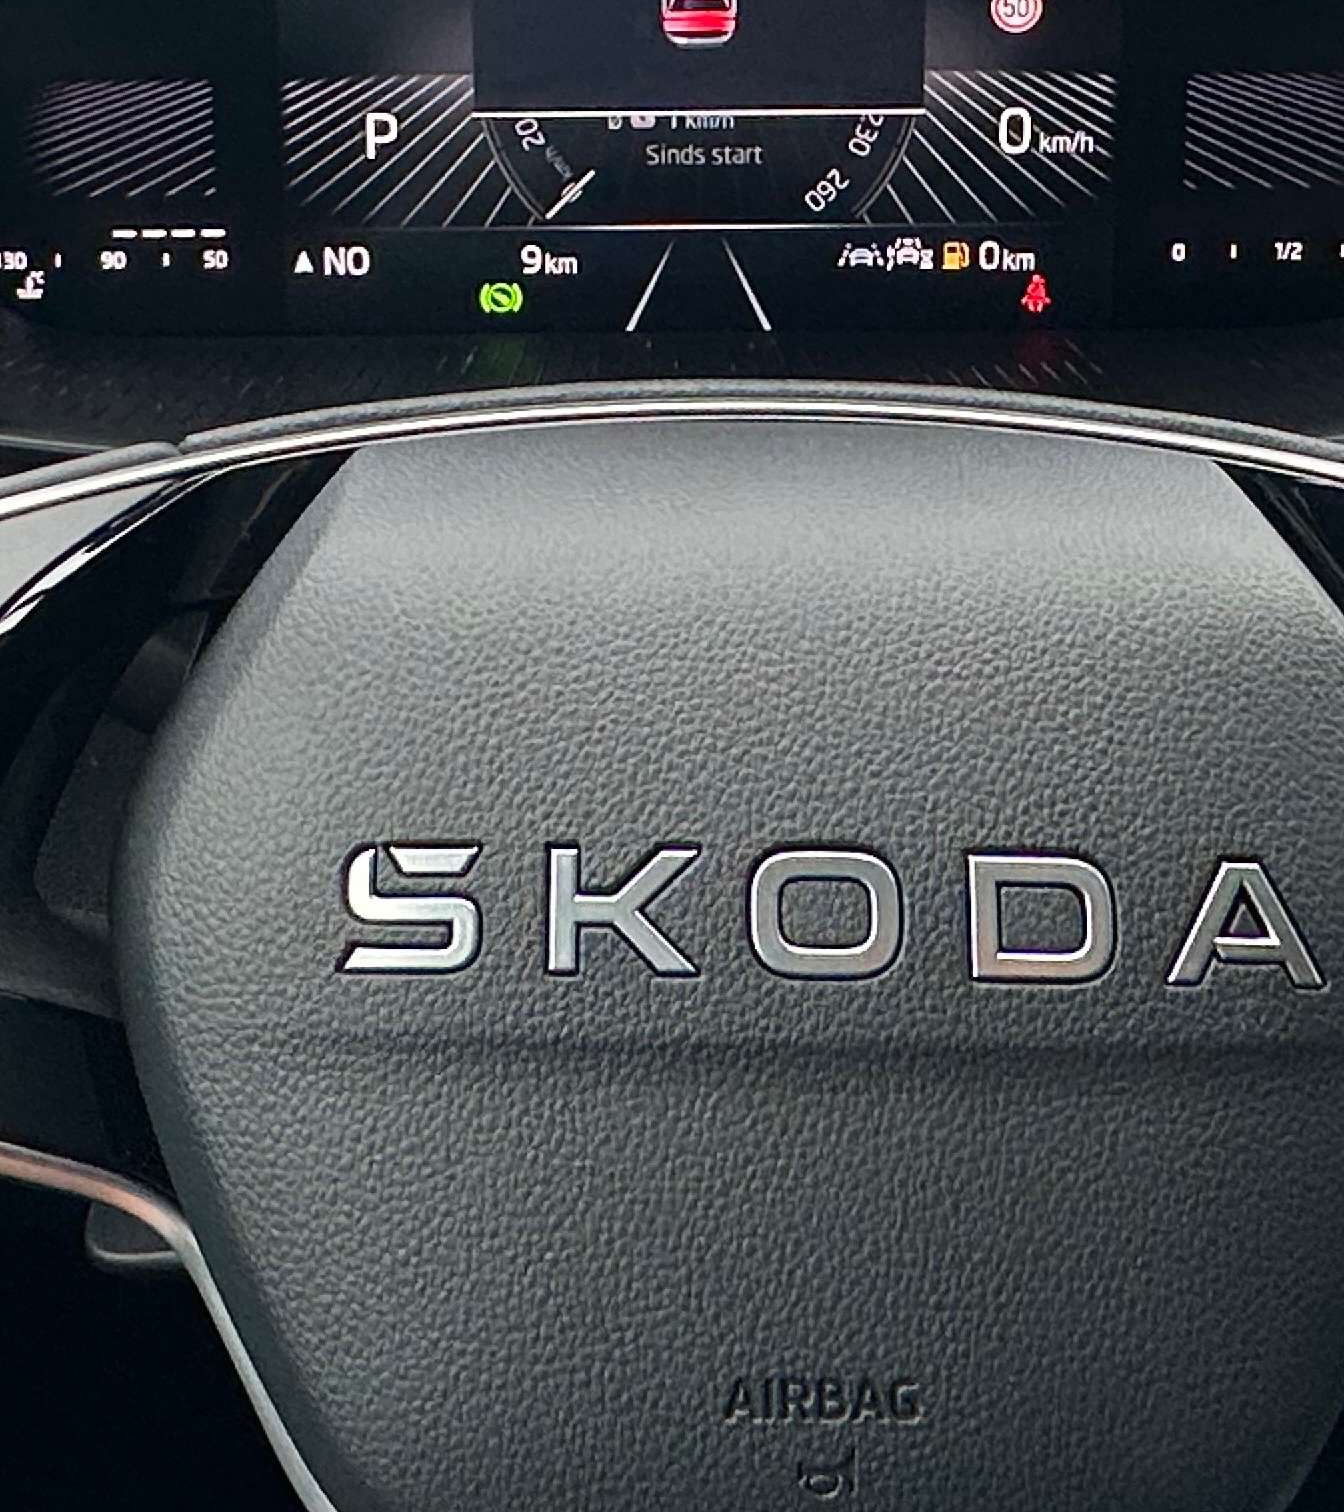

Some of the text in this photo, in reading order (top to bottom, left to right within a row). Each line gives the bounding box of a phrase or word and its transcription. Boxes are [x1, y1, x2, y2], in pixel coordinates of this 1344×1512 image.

[365, 112, 399, 160] P
[514, 117, 546, 152] 20
[998, 106, 1095, 156] 0 km/h
[646, 143, 763, 166] Sinds start
[804, 167, 851, 213] 260
[100, 250, 128, 270] 90
[203, 249, 229, 269] 50
[323, 247, 371, 276] NO
[1171, 242, 1186, 262] 0
[1274, 241, 1303, 261] 1/2
[723, 1376, 928, 1426] AIRBAG
